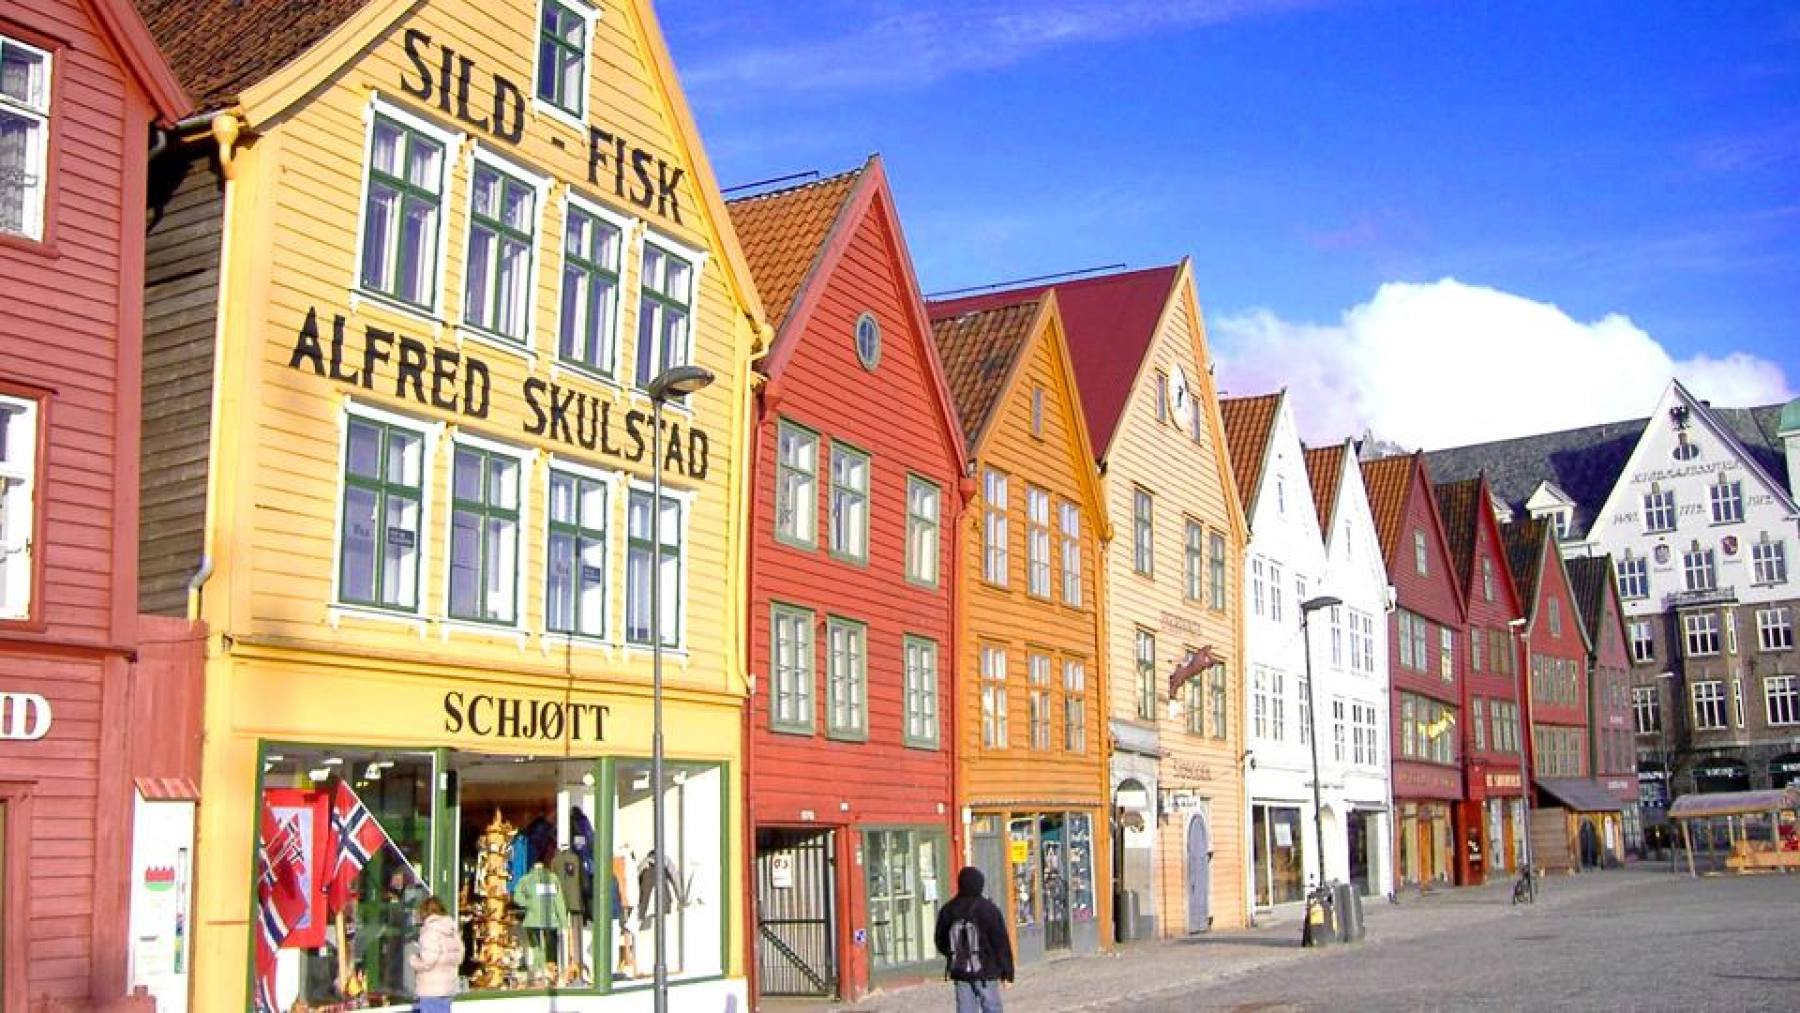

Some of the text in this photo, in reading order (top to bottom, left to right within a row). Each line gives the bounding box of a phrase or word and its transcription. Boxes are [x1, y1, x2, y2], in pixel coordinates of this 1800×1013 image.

[401, 28, 685, 225] SILD - FISK
[289, 306, 709, 480] ALFRED SKULSTAD
[443, 690, 609, 742] SCHJØTT
